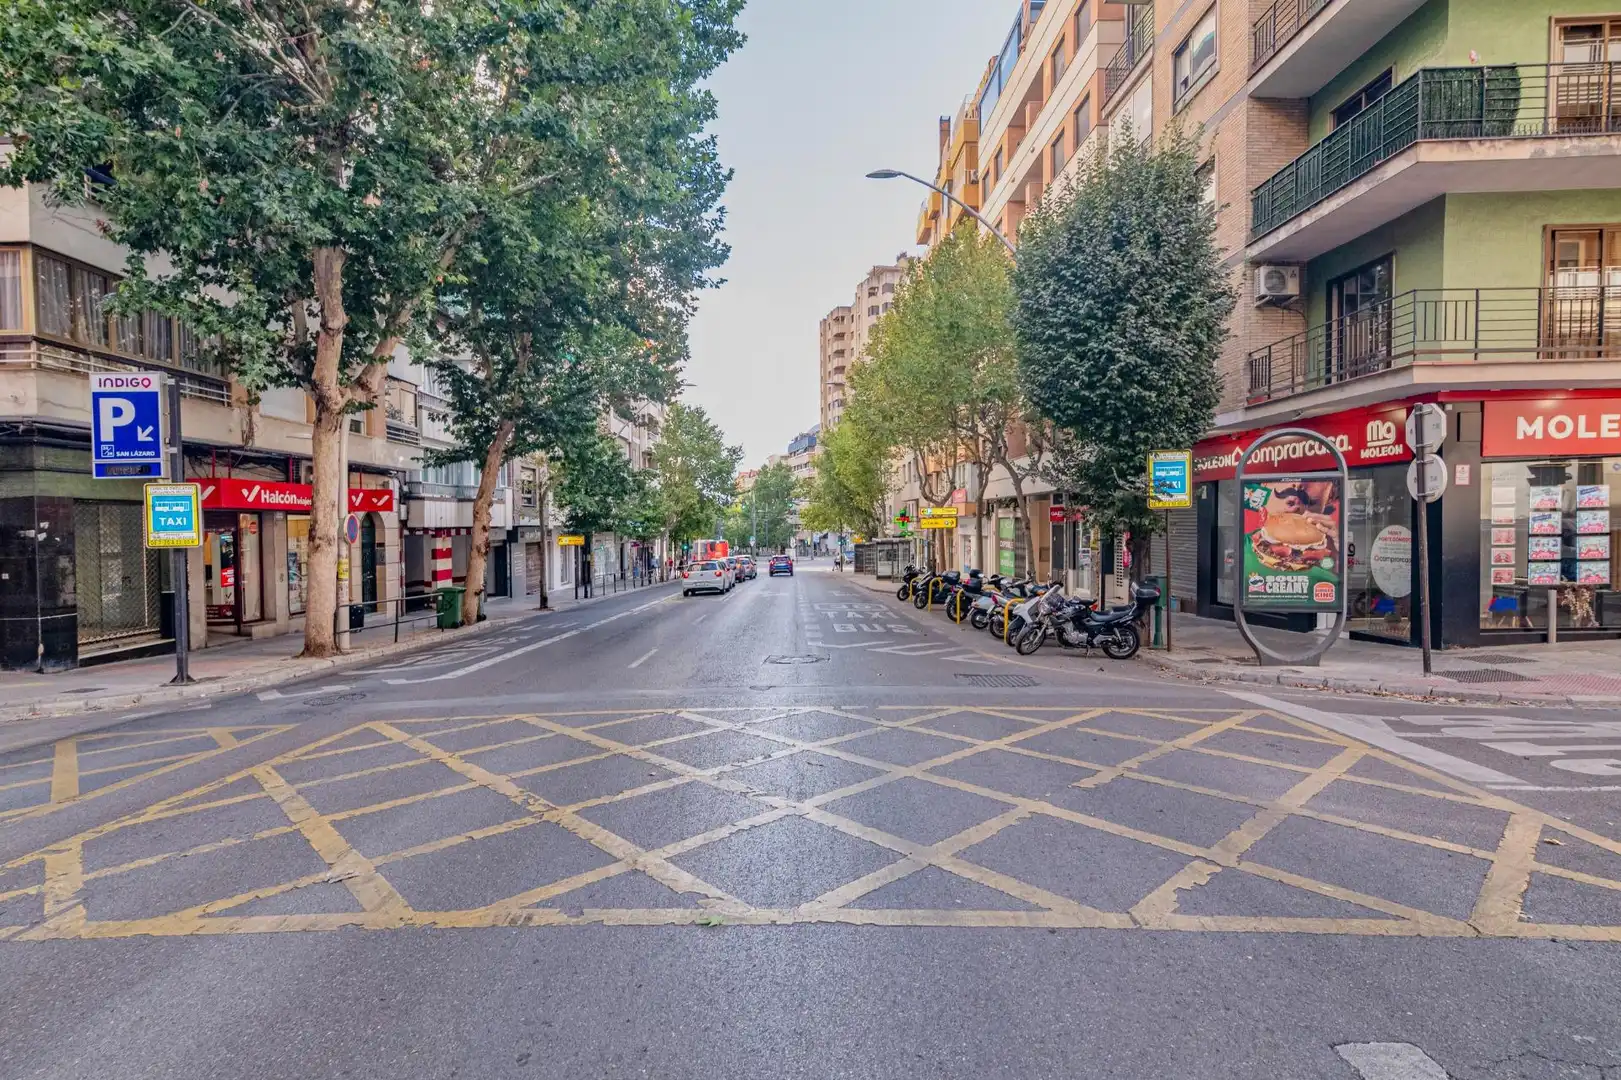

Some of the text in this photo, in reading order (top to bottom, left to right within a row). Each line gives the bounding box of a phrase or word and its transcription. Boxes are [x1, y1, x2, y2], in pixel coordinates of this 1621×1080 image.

[98, 397, 136, 442] P
[1516, 413, 1621, 440] MOLE
[131, 449, 156, 457] LÁZARO
[1195, 434, 1353, 470] OLEON omprarcaa.
[1360, 444, 1403, 459] MOLEON
[260, 489, 297, 504] Halcón
[158, 517, 187, 526] TAXI
[1265, 582, 1309, 593] CREAMY
[820, 611, 900, 619] TAXI
[832, 623, 918, 635] BUS
